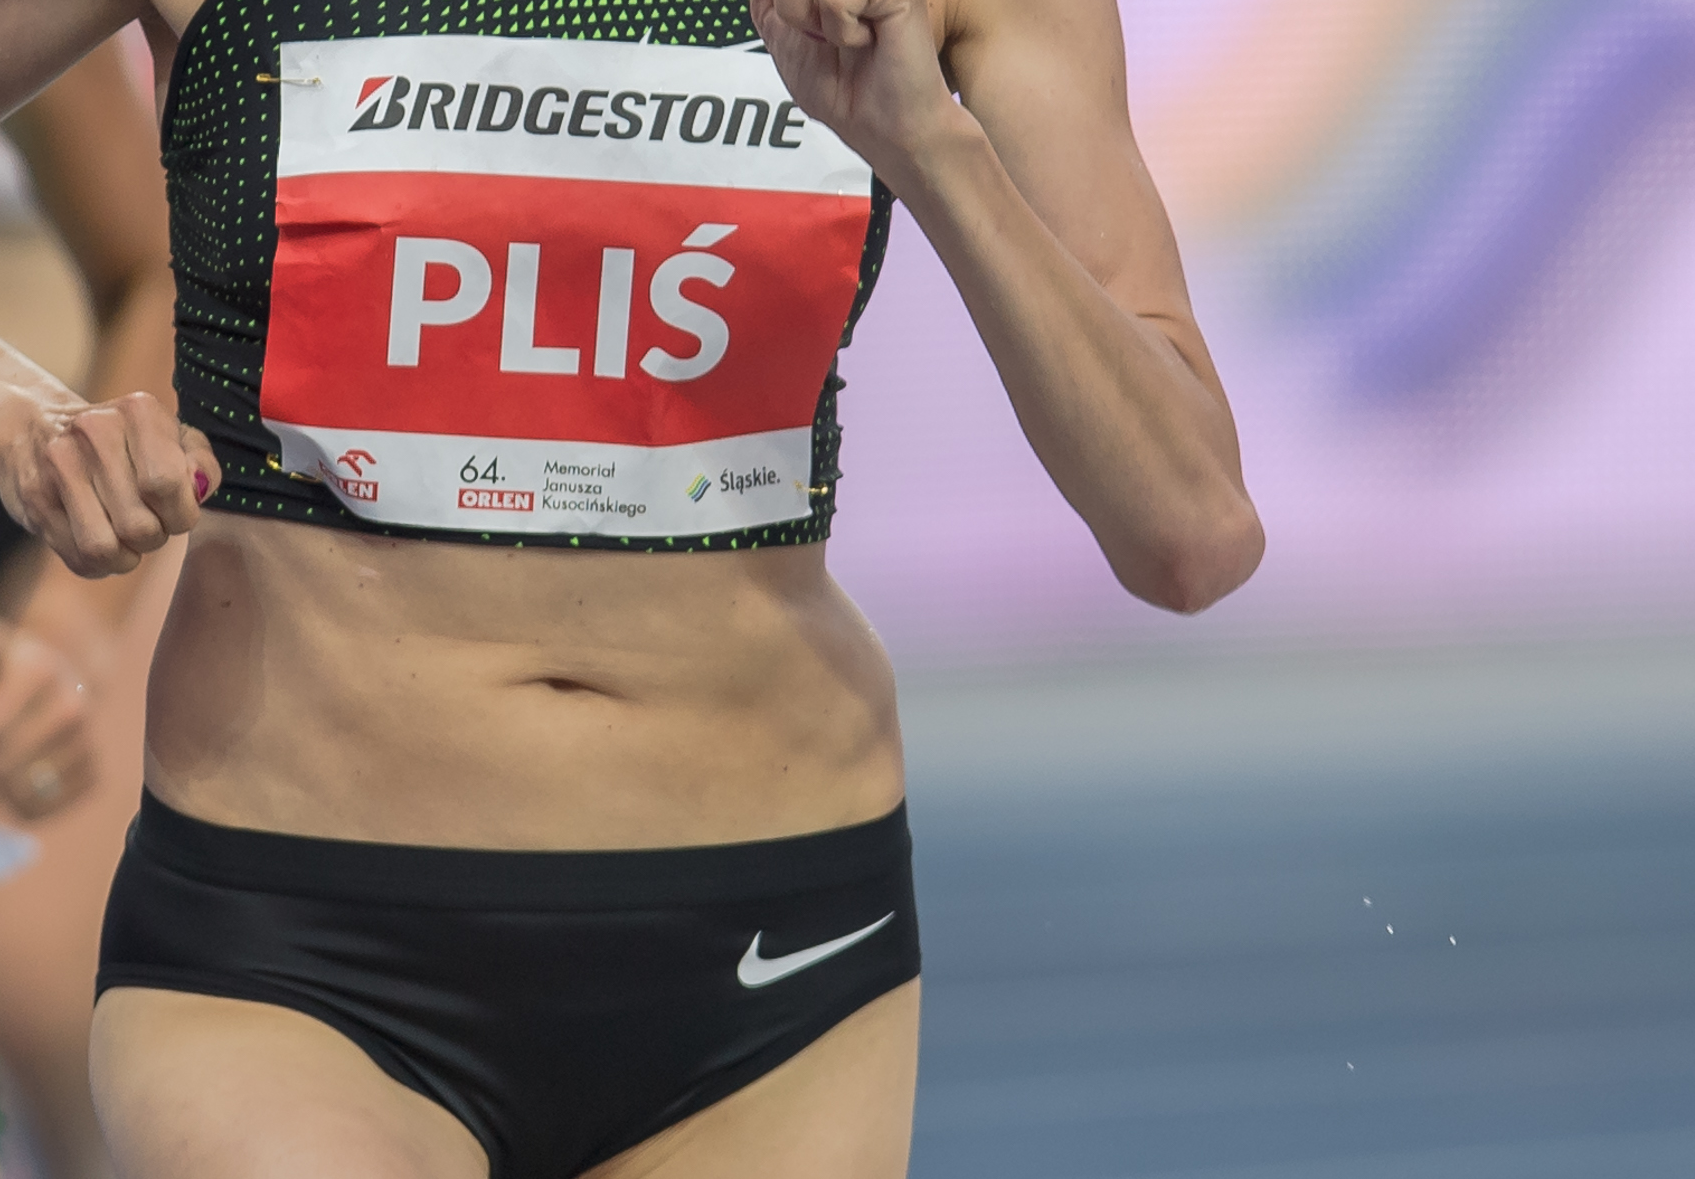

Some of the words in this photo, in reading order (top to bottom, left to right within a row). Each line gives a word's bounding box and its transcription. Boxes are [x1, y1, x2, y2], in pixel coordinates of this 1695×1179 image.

[348, 76, 806, 149] BRIDGESTONE
[386, 223, 739, 383] PLIŚ
[460, 455, 506, 485] 64.
[543, 460, 616, 478] Memoriał
[720, 466, 781, 495] Śląskie.
[542, 478, 603, 495] Janusza
[462, 491, 529, 509] ORLEN
[541, 495, 647, 518] Kusocińskiego
